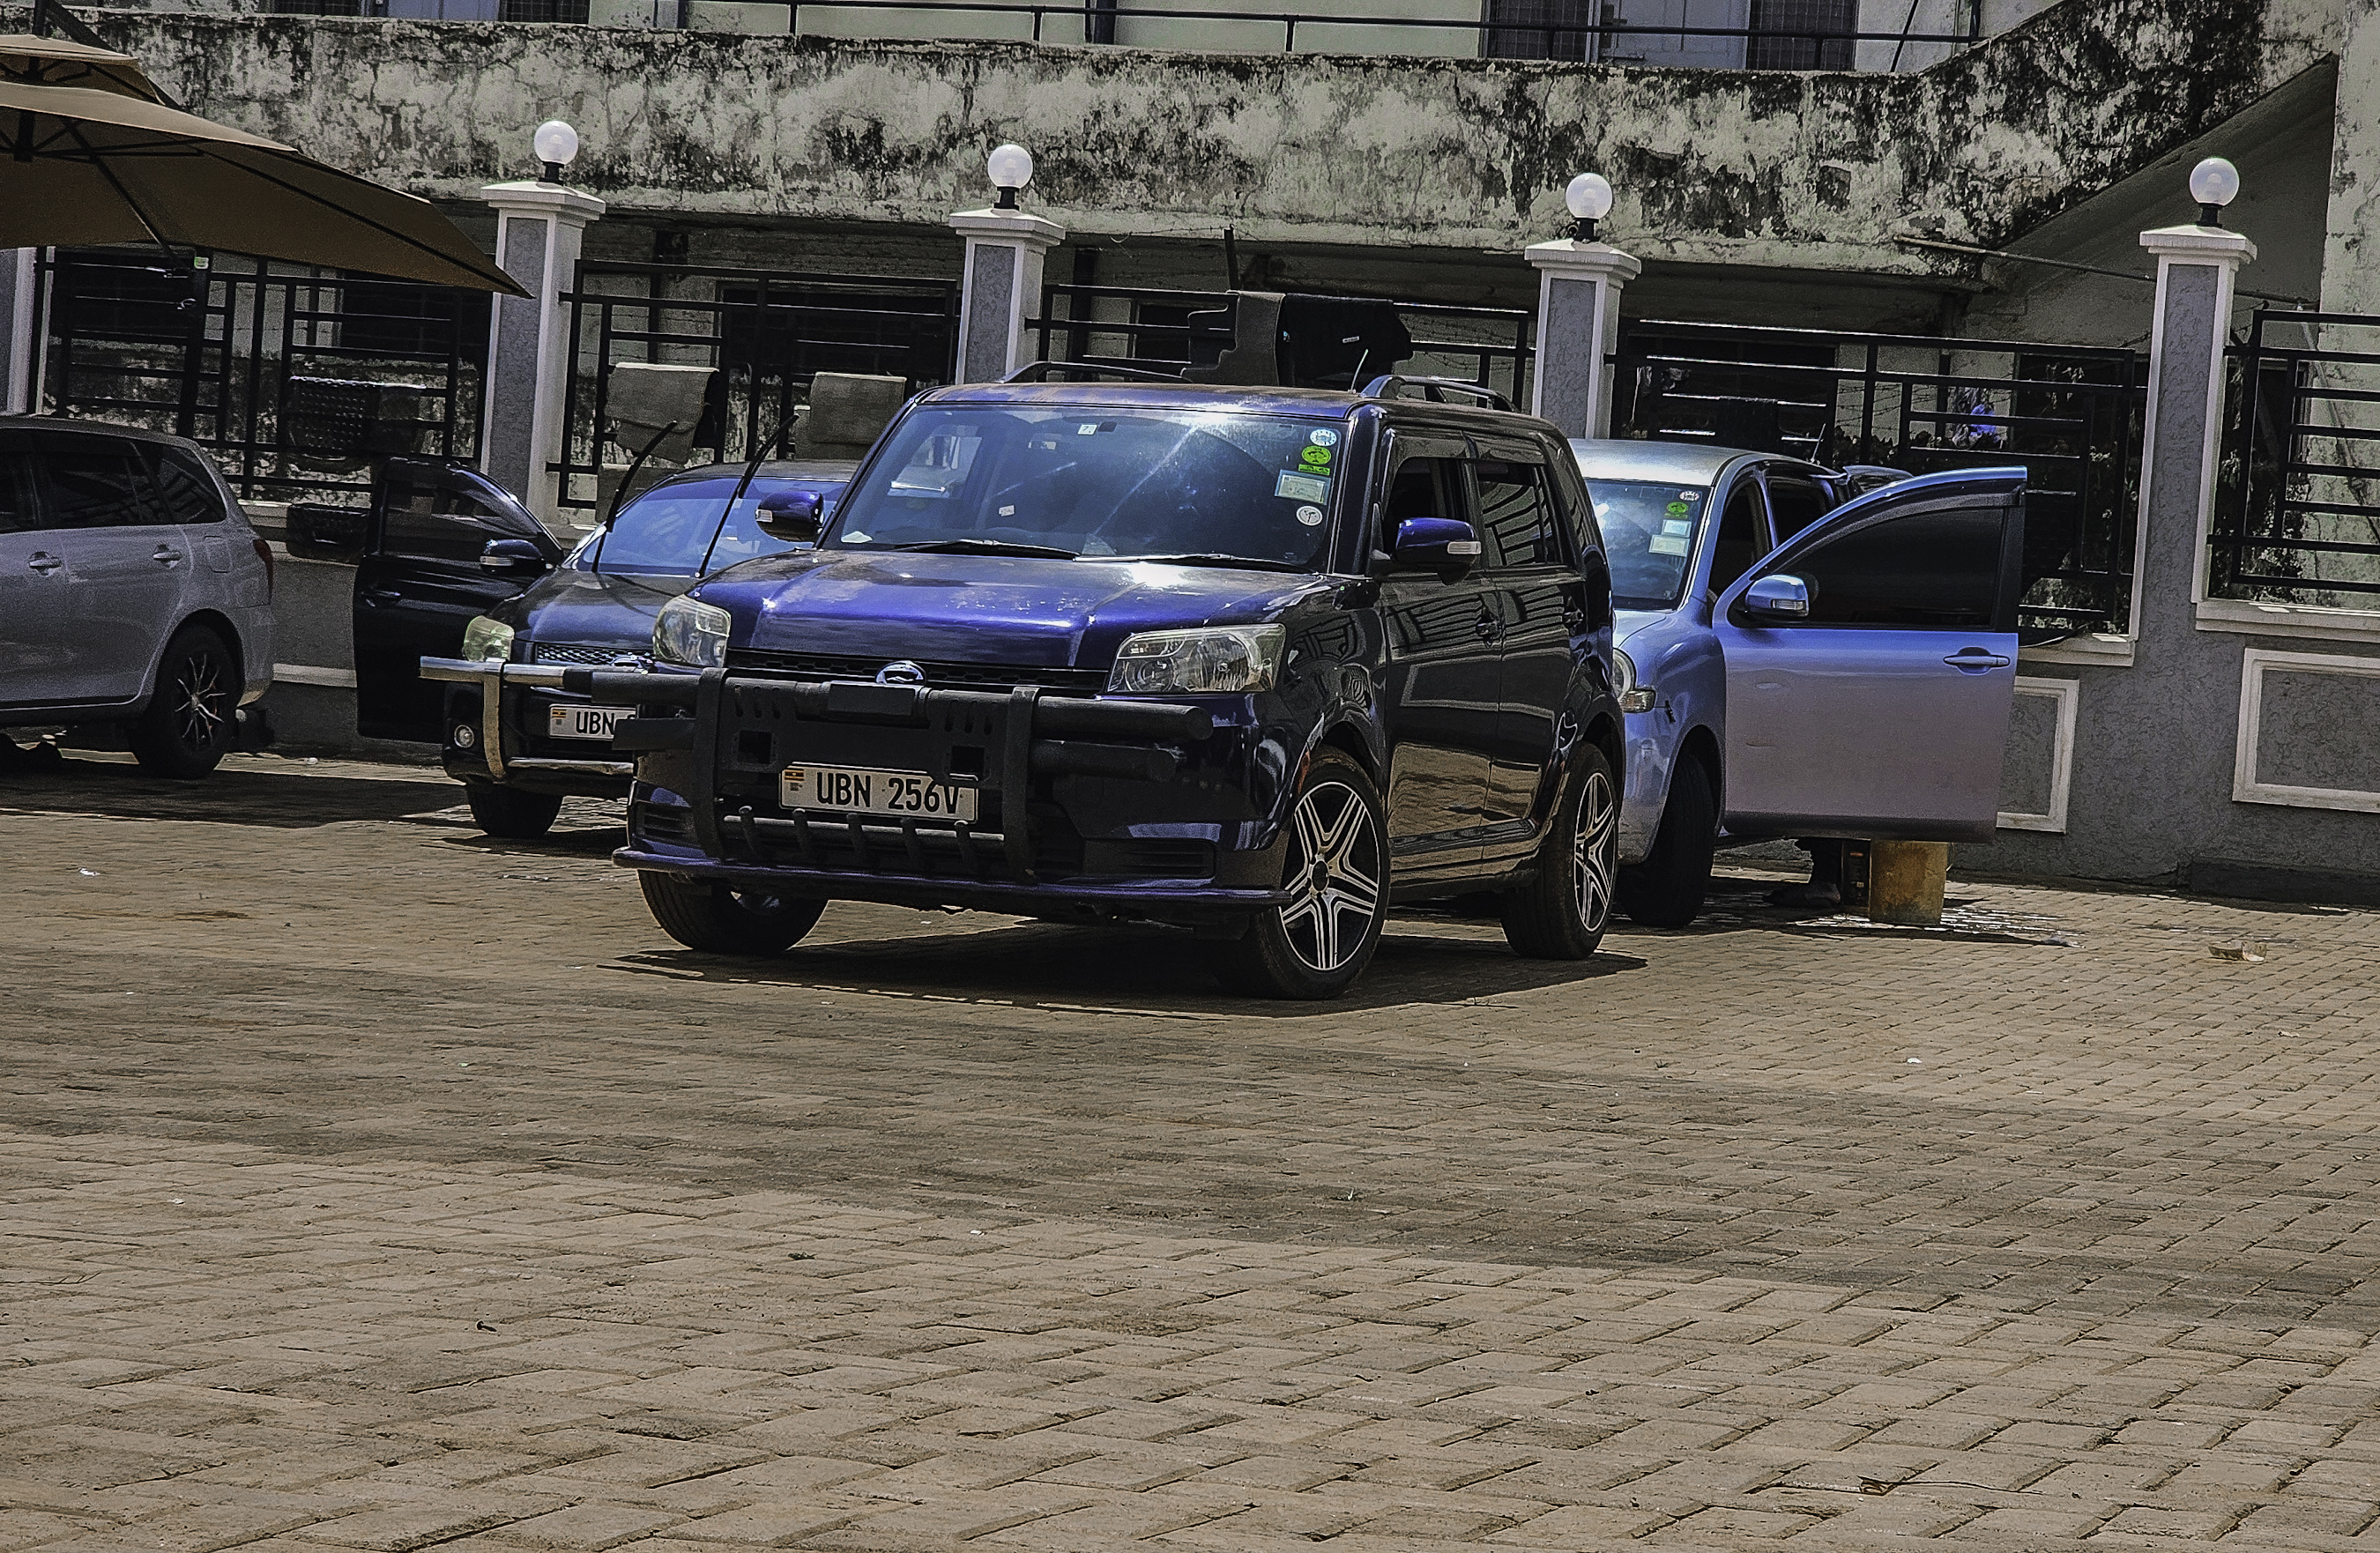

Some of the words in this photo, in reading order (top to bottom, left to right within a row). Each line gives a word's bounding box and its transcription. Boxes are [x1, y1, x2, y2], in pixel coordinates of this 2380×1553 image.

[576, 711, 615, 735] UBN
[816, 771, 871, 808] UBN
[888, 777, 959, 814] 256V
